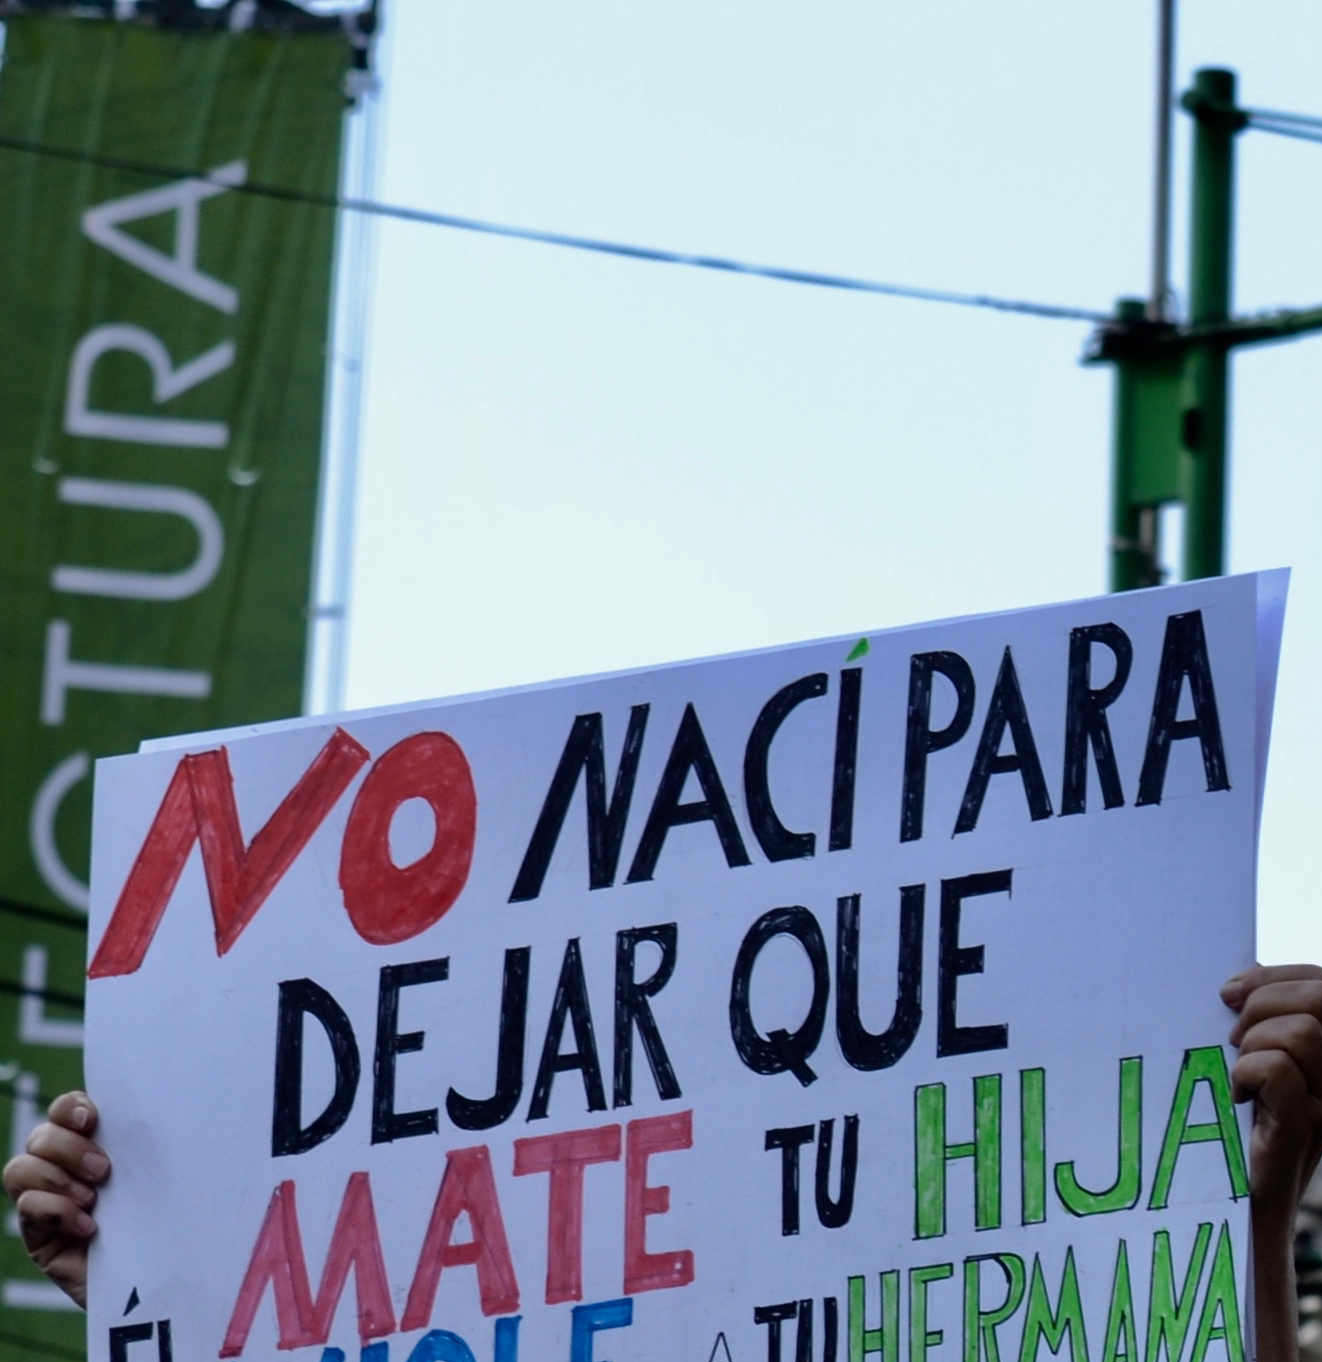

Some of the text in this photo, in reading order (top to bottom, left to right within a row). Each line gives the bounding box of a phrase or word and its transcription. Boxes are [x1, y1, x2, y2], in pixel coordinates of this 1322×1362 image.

[86, 609, 1233, 978] NO NACÍ PARA
[271, 868, 1015, 1159] DEJAR QUE
[218, 1044, 1253, 1359] MATE TU HIJA
